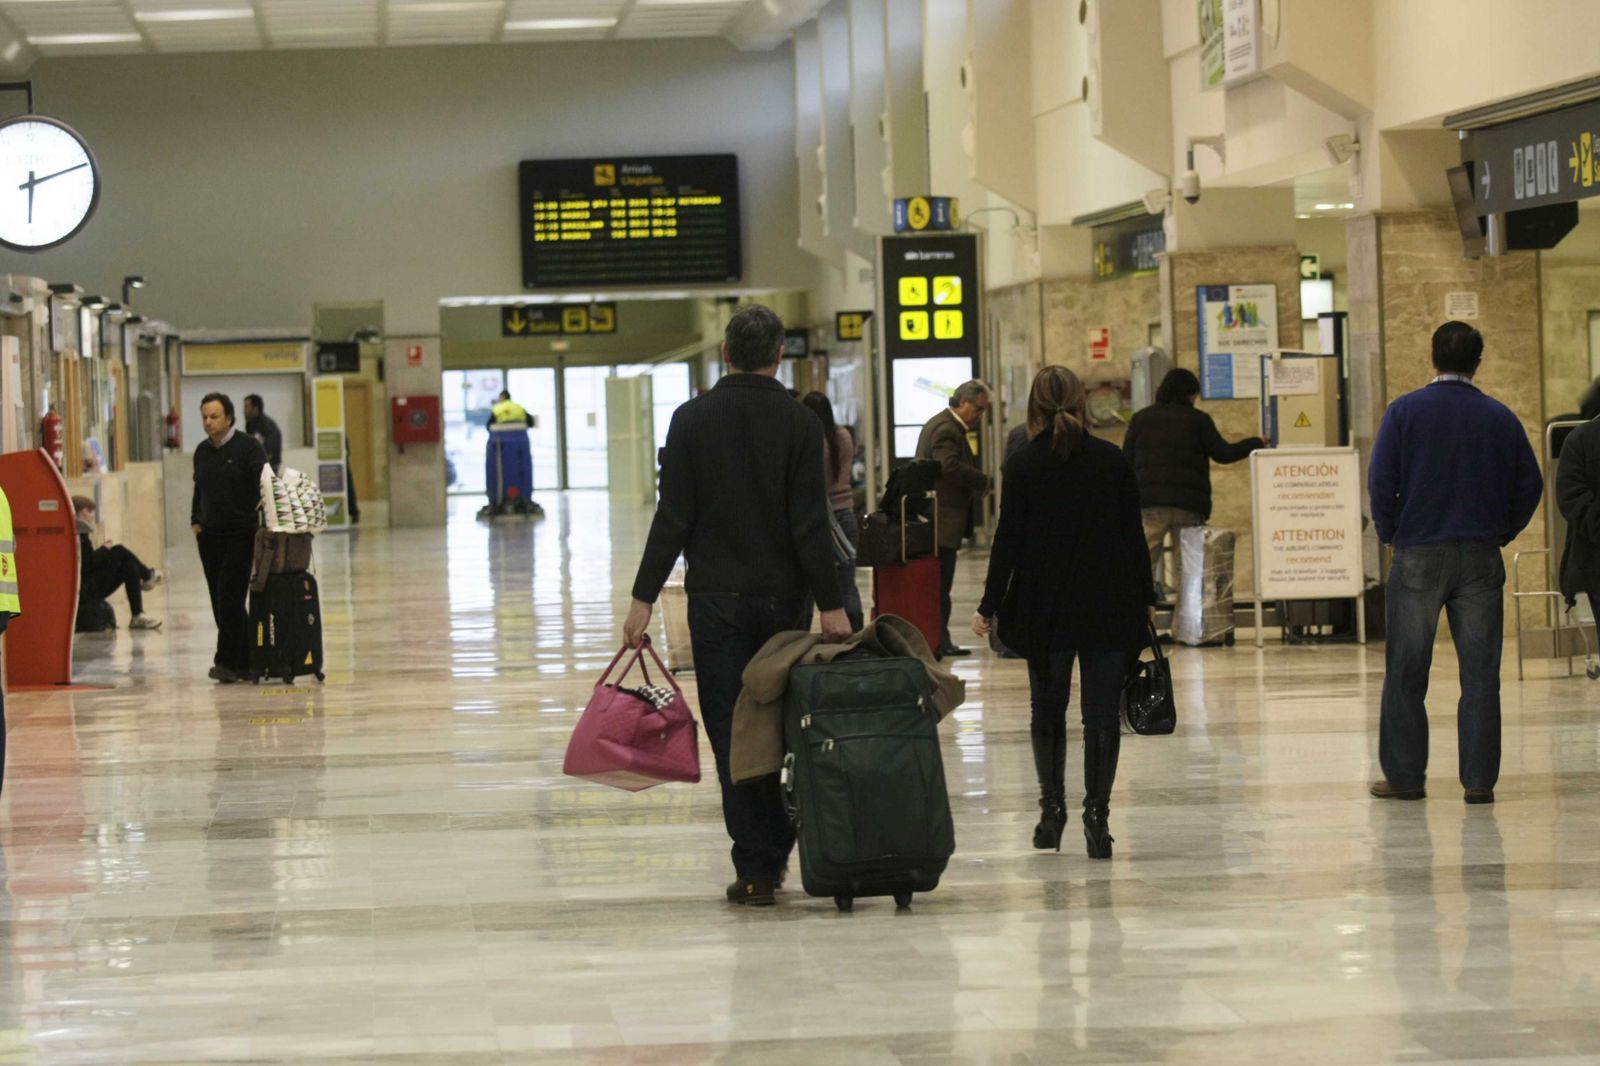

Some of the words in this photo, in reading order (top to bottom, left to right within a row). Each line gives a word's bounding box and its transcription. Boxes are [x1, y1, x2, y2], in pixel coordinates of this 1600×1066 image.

[1274, 462, 1338, 477] ATENCIÓN
[1278, 491, 1335, 500] recomiendan
[1272, 529, 1344, 541] ATTENTION
